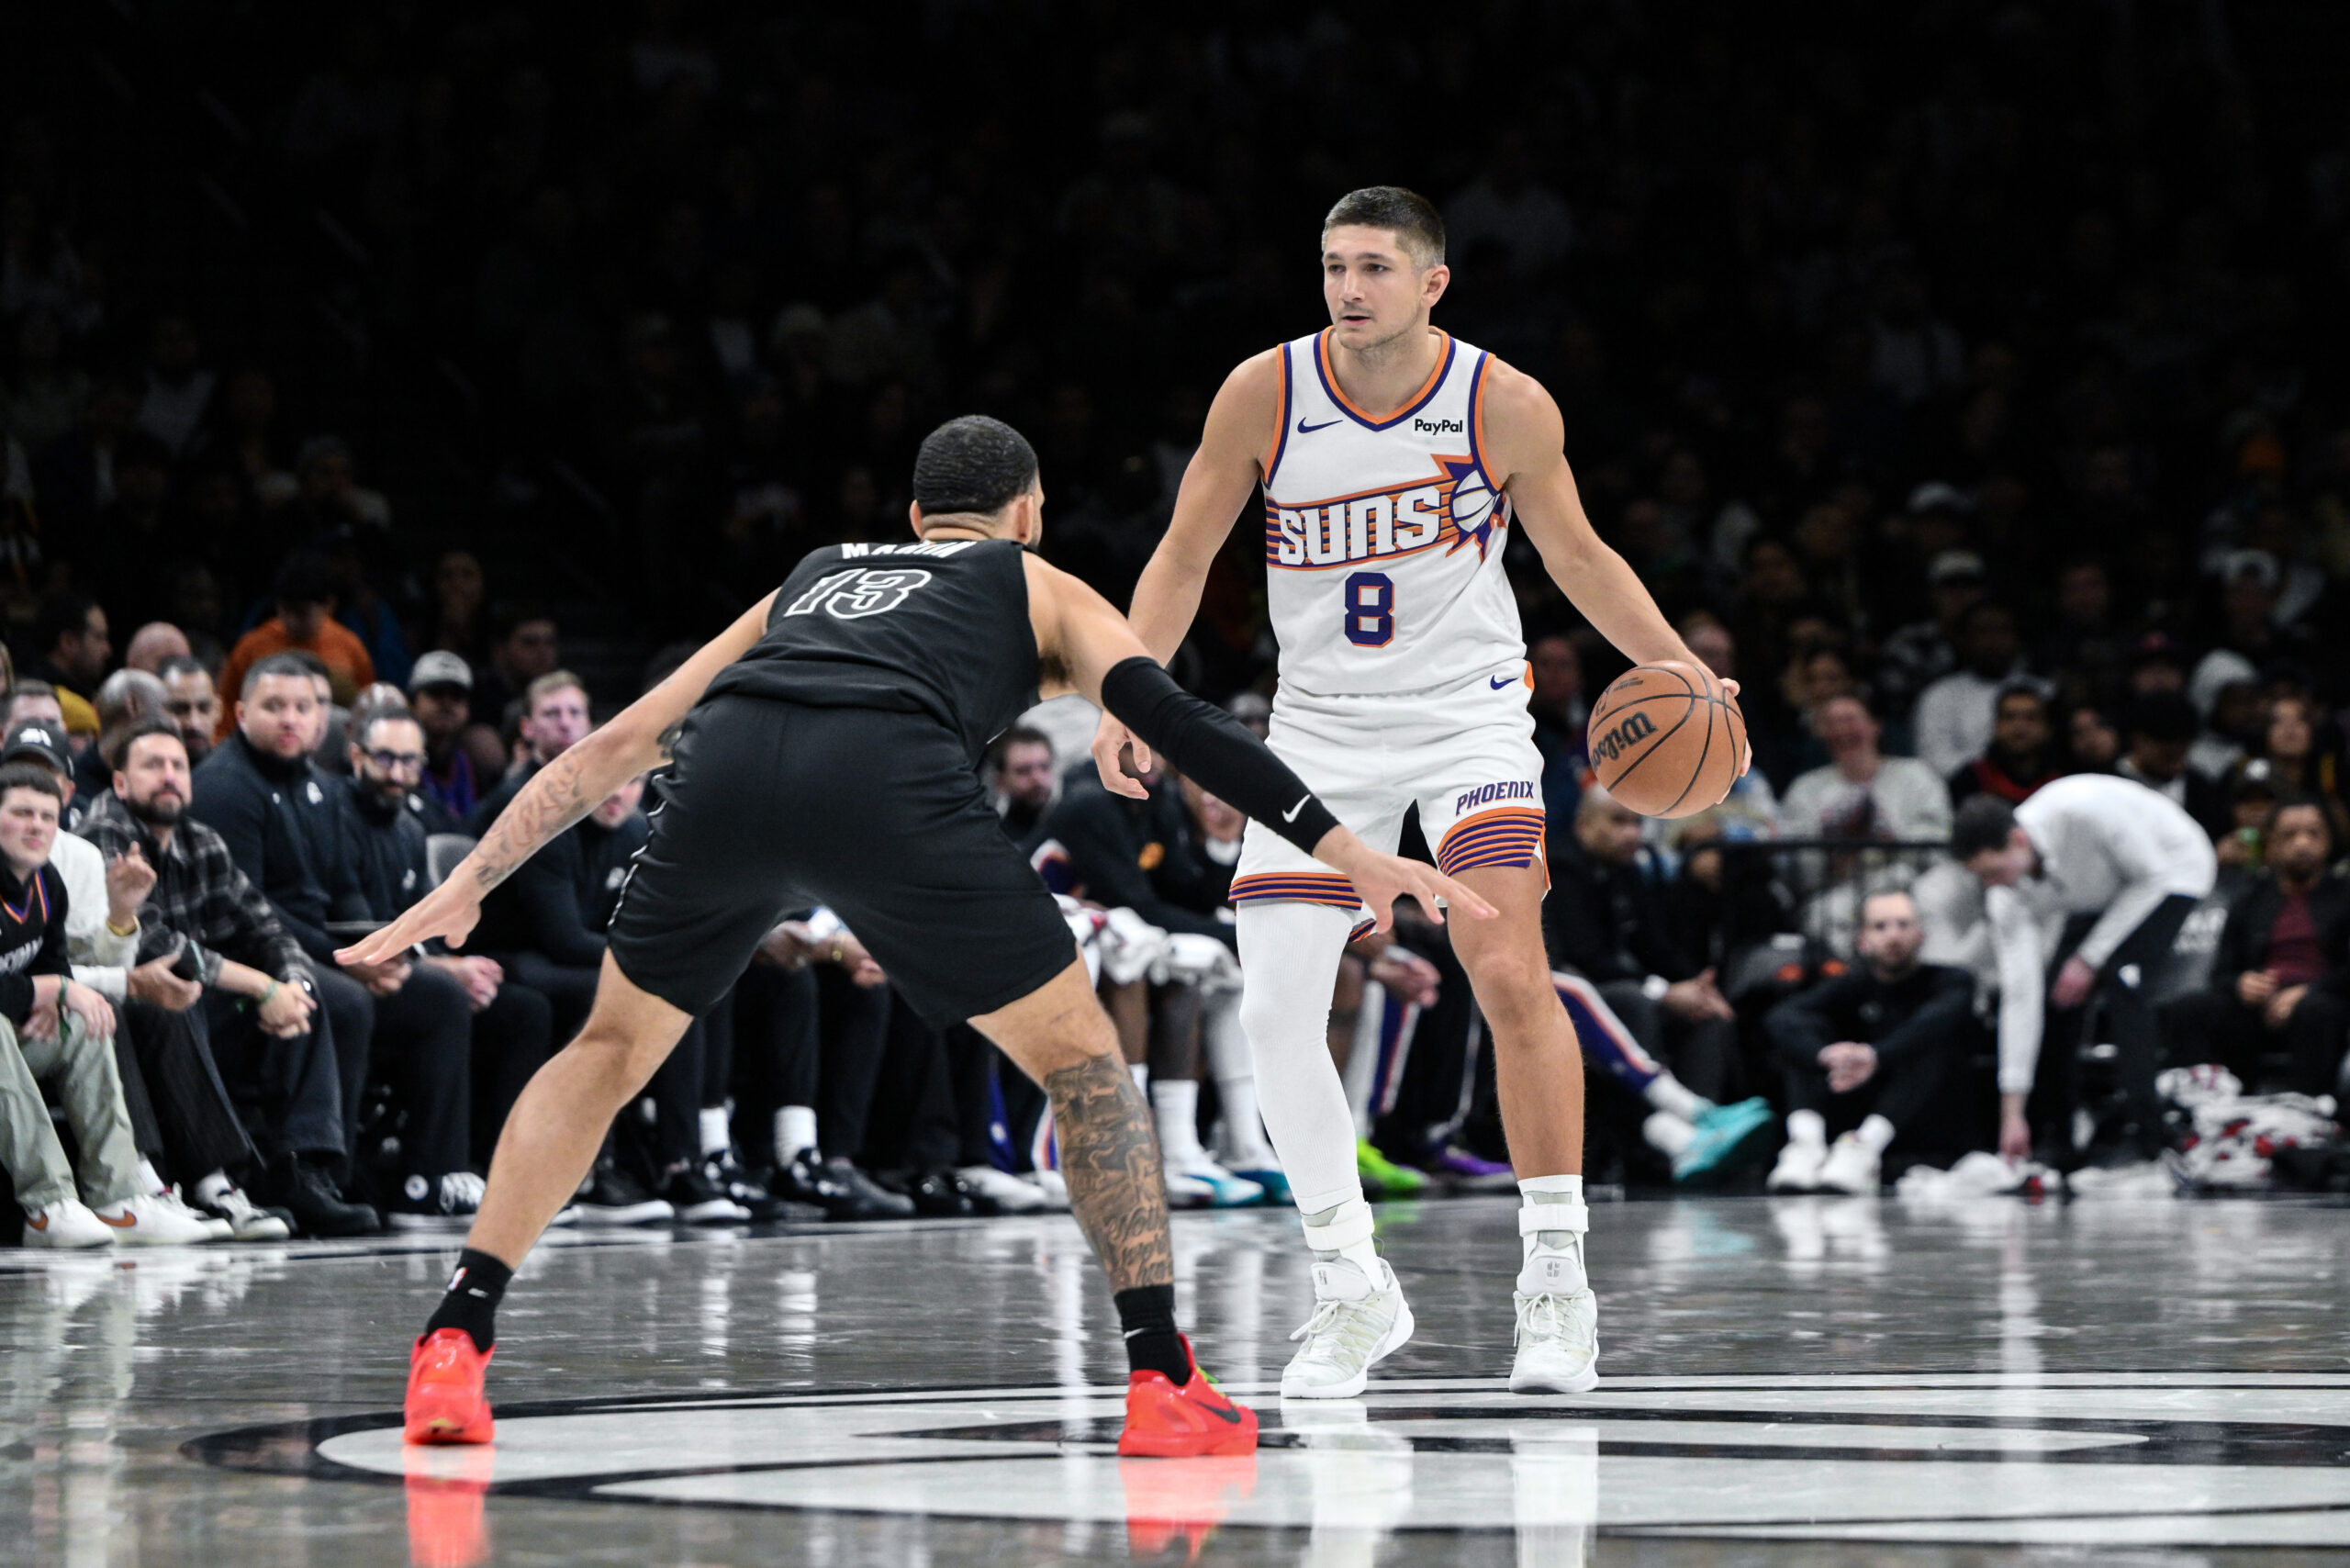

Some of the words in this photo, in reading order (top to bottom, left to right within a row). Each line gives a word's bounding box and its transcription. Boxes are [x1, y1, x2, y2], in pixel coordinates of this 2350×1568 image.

[1415, 419, 1462, 435] PayPal
[1278, 486, 1441, 566] SUNS
[783, 567, 932, 620] 13
[1345, 572, 1394, 648] 8
[1456, 780, 1535, 816] PHOENIX
